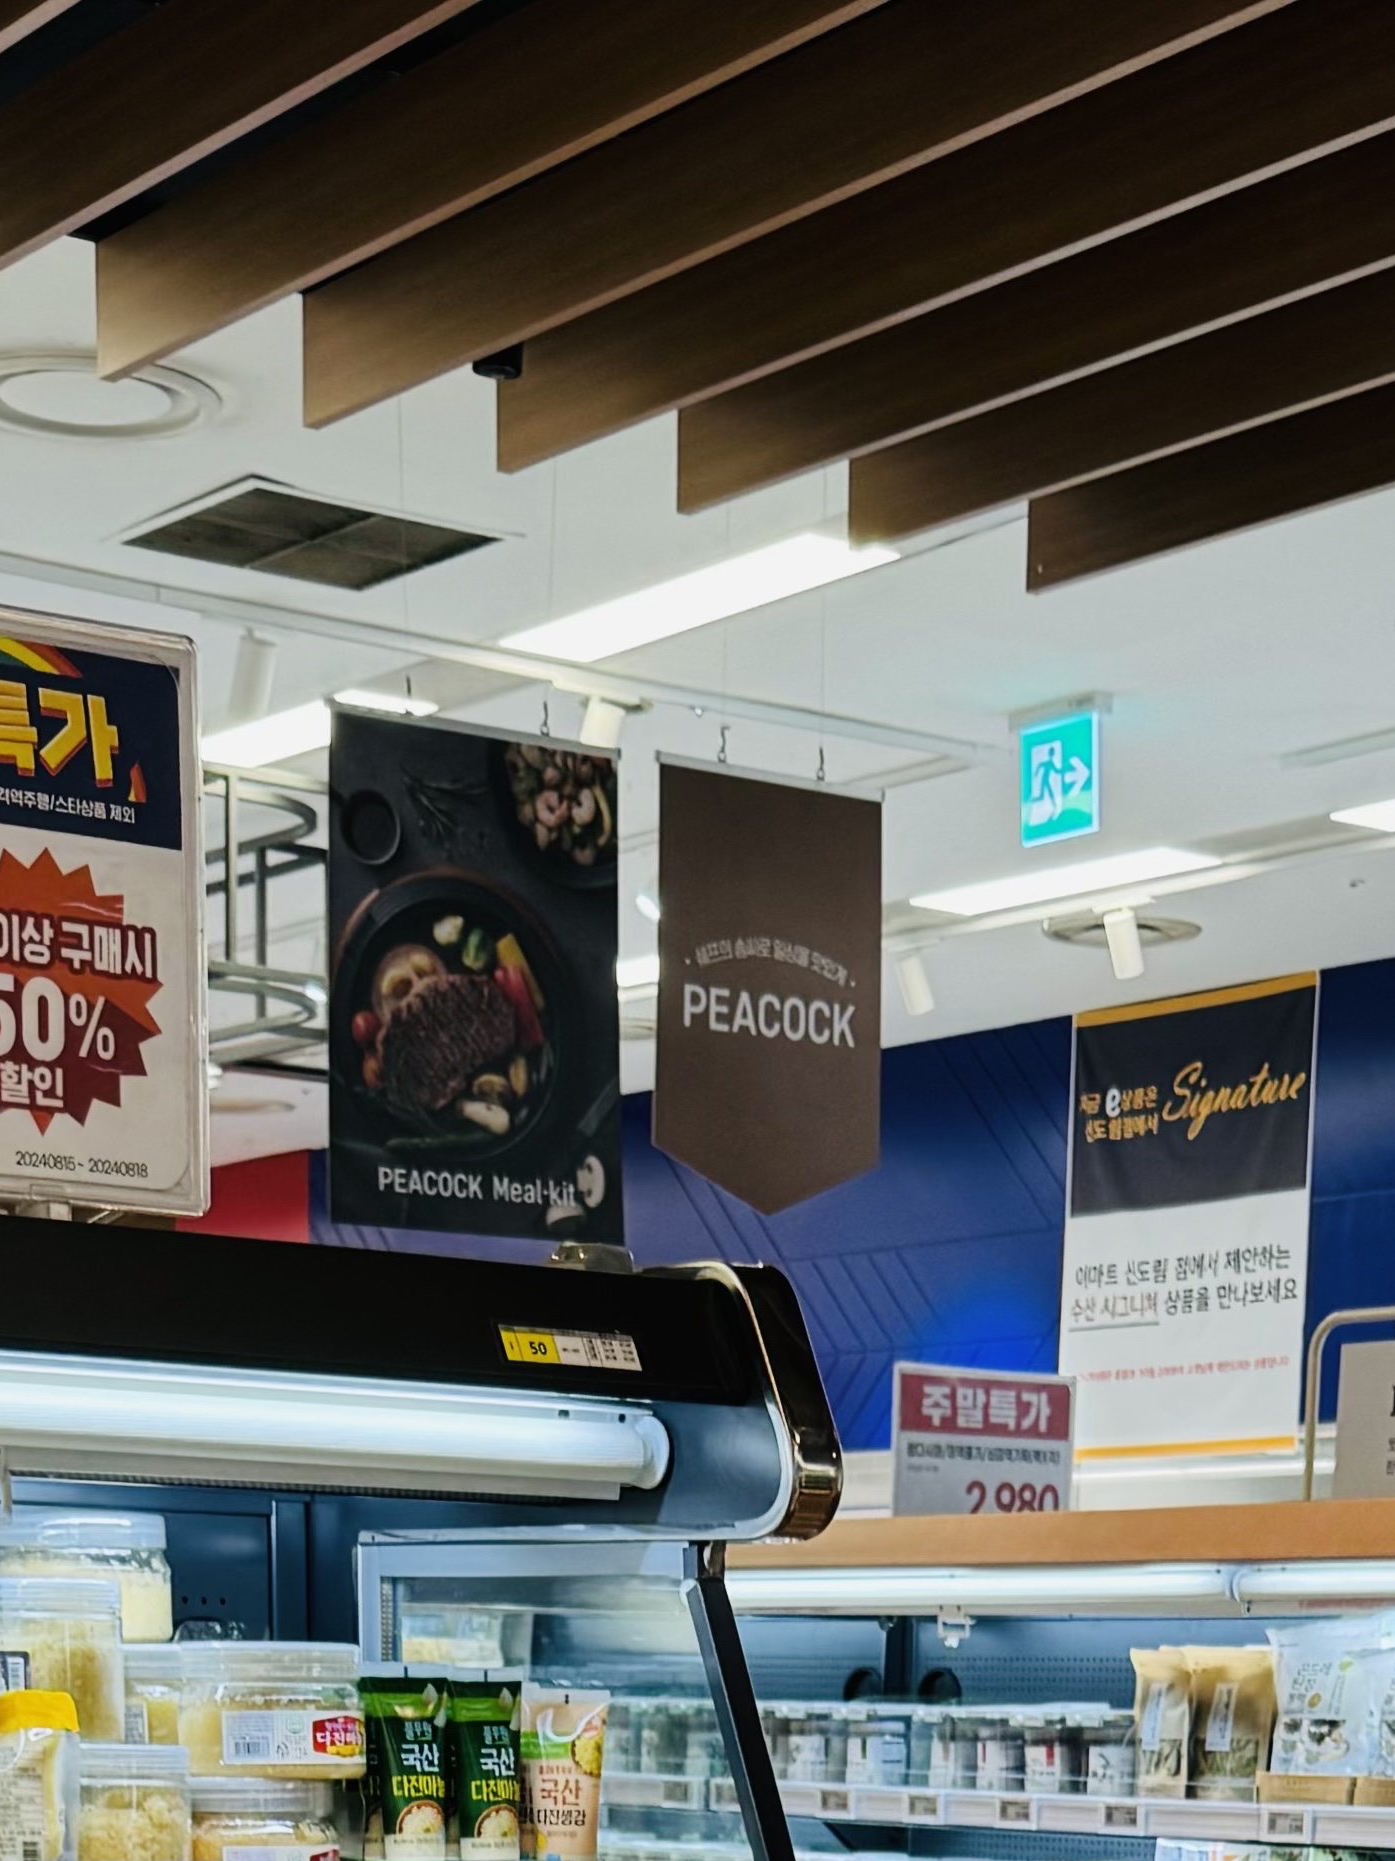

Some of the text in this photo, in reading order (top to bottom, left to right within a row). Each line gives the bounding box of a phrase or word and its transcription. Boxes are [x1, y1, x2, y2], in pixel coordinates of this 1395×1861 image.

[109, 801, 137, 824] 제외
[60, 920, 154, 979] 구매시
[682, 982, 856, 1049] PEACOCK
[1162, 1060, 1306, 1141] Signature
[377, 1164, 483, 1201] PEACOCK
[1075, 1263, 1118, 1289] 이마트
[1224, 1244, 1292, 1275] 제안하는
[1216, 1277, 1299, 1311] 만나보세요
[528, 1341, 548, 1355] 50
[921, 1384, 1052, 1433] 주말특가
[401, 1744, 440, 1773] 국산
[479, 1748, 516, 1777] 국산
[539, 1778, 583, 1807] 국산
[537, 1807, 587, 1828] 다진생강
